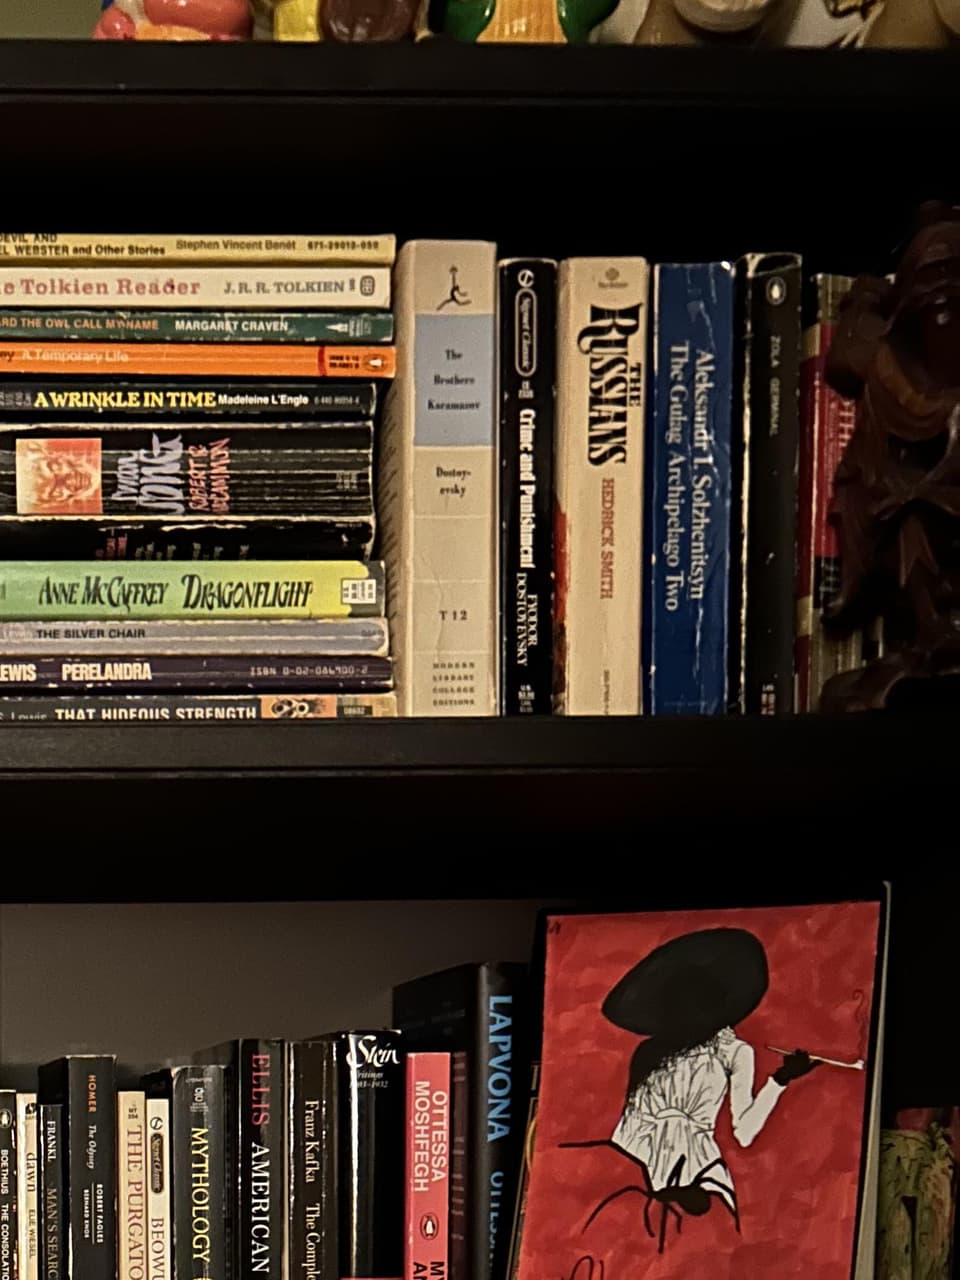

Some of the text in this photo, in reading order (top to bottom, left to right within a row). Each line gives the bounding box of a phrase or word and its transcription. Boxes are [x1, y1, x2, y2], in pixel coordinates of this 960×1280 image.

[16, 246, 70, 257] WEBSTER
[72, 247, 93, 257] and
[95, 247, 124, 257] Other
[127, 247, 166, 258] Stories
[20, 278, 102, 295] Tolkien
[116, 279, 201, 295] Reader
[174, 319, 289, 333] MARGARET CRAVEN
[433, 375, 476, 386] Brothers
[578, 303, 644, 468] RUSSIANS
[769, 335, 782, 438] ZOLA GERMINAL
[519, 408, 537, 569] Crime and Punishment
[600, 477, 616, 600] HEDRICK SMITH
[180, 573, 313, 611] DRAGONFLIGHT
[36, 629, 146, 639] THE SILVER CHAIR
[515, 573, 529, 667] DOSTOYEVSKY
[527, 593, 539, 646] FYODOR
[88, 1074, 98, 1113] HOMER
[251, 1052, 271, 1127] ELLIS
[486, 994, 514, 1143] LAPVONA
[46, 1120, 58, 1162] FRANKL
[127, 1124, 144, 1173] THE
[414, 1080, 431, 1192] MOSHFEGH
[431, 1089, 447, 1182] OTTESSA
[0, 1149, 10, 1194] BOETHIUS
[191, 1127, 211, 1262] MYTHOLOGY
[46, 1187, 59, 1227] MAN'S
[251, 1141, 271, 1274] AMERICAN
